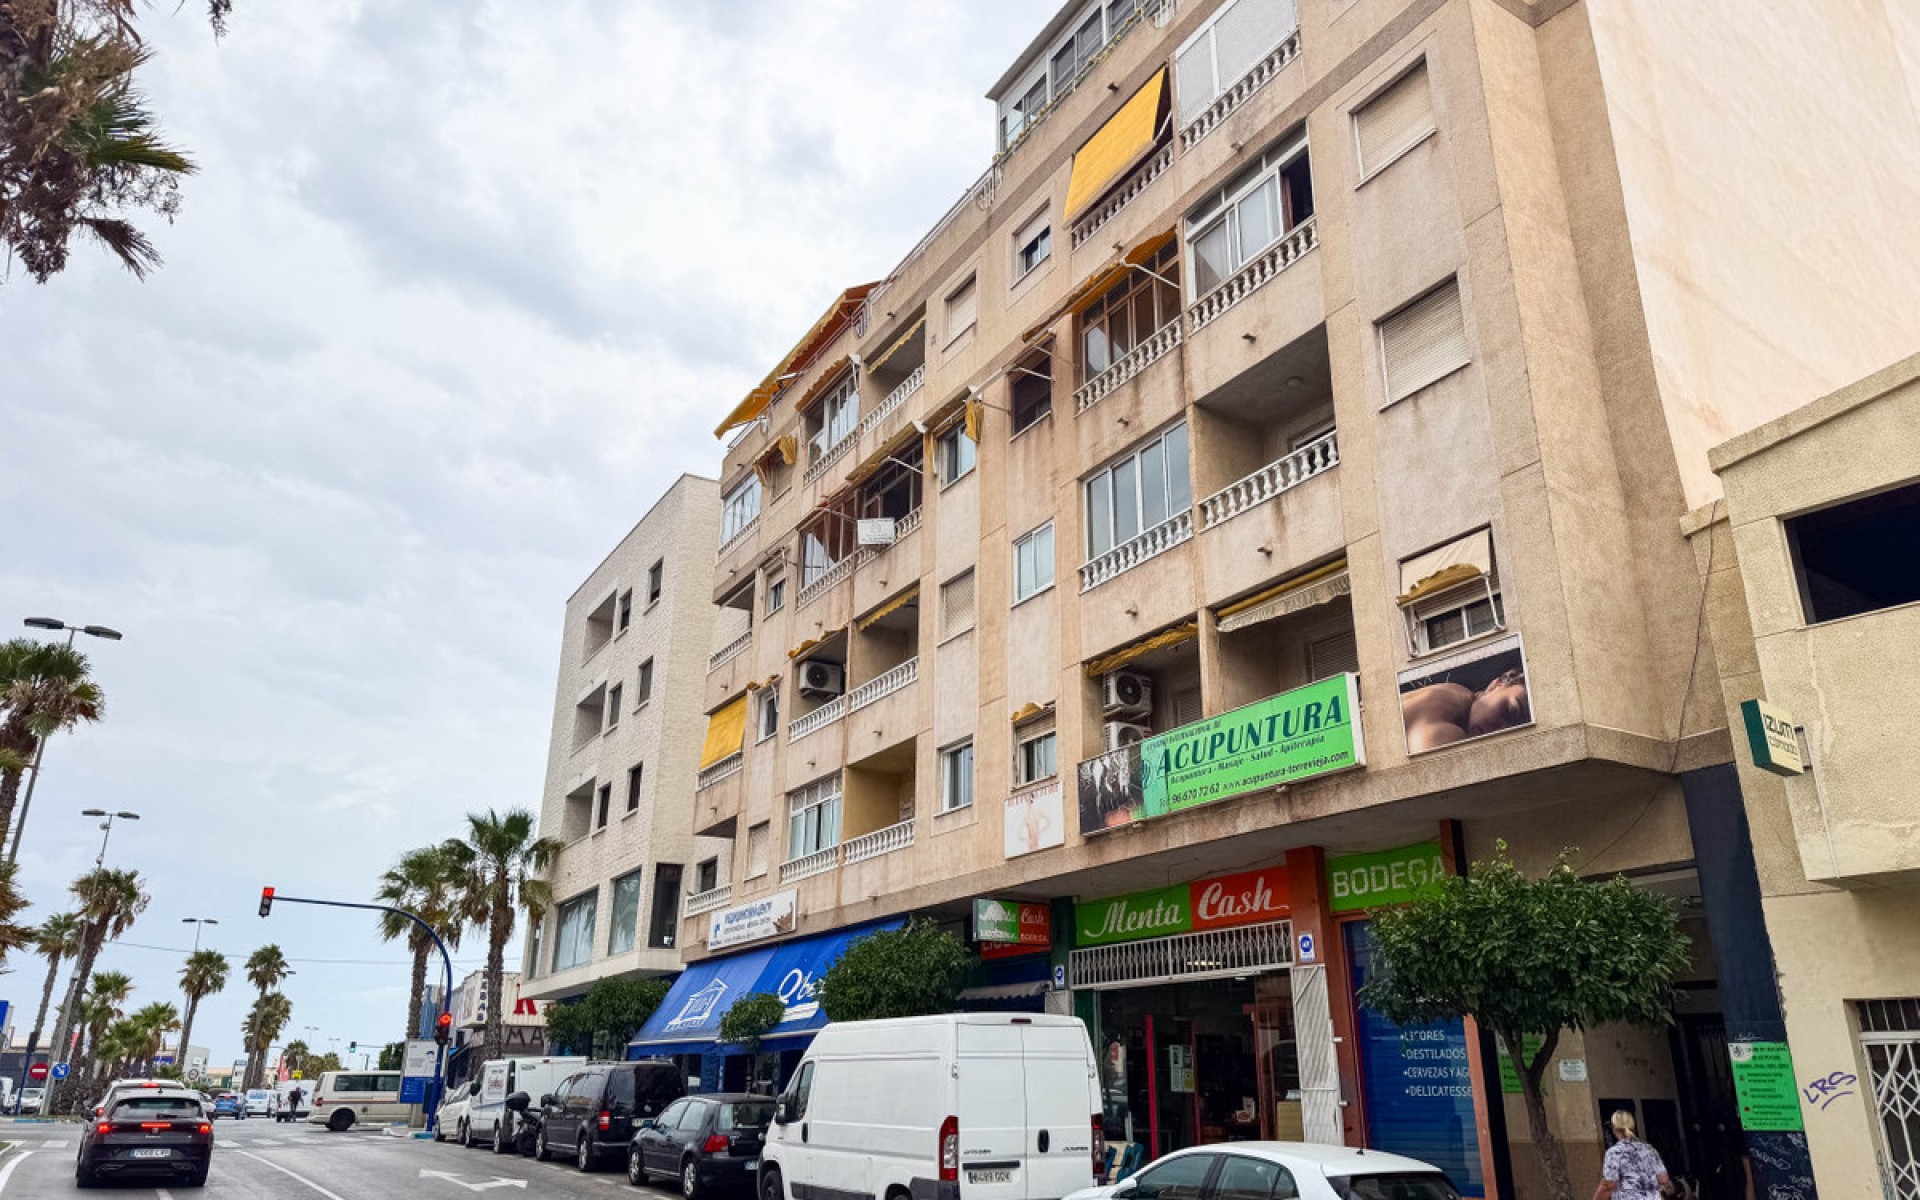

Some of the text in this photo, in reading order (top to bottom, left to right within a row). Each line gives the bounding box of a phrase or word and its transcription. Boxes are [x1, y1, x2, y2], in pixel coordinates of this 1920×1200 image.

[1157, 695, 1342, 777] ACUPUNTURA
[1332, 855, 1445, 898] BODEGA
[1084, 876, 1290, 938] Menta Cash
[1406, 1047, 1467, 1060] DESTILADOS
[1408, 1066, 1449, 1079] CERVEZAS
